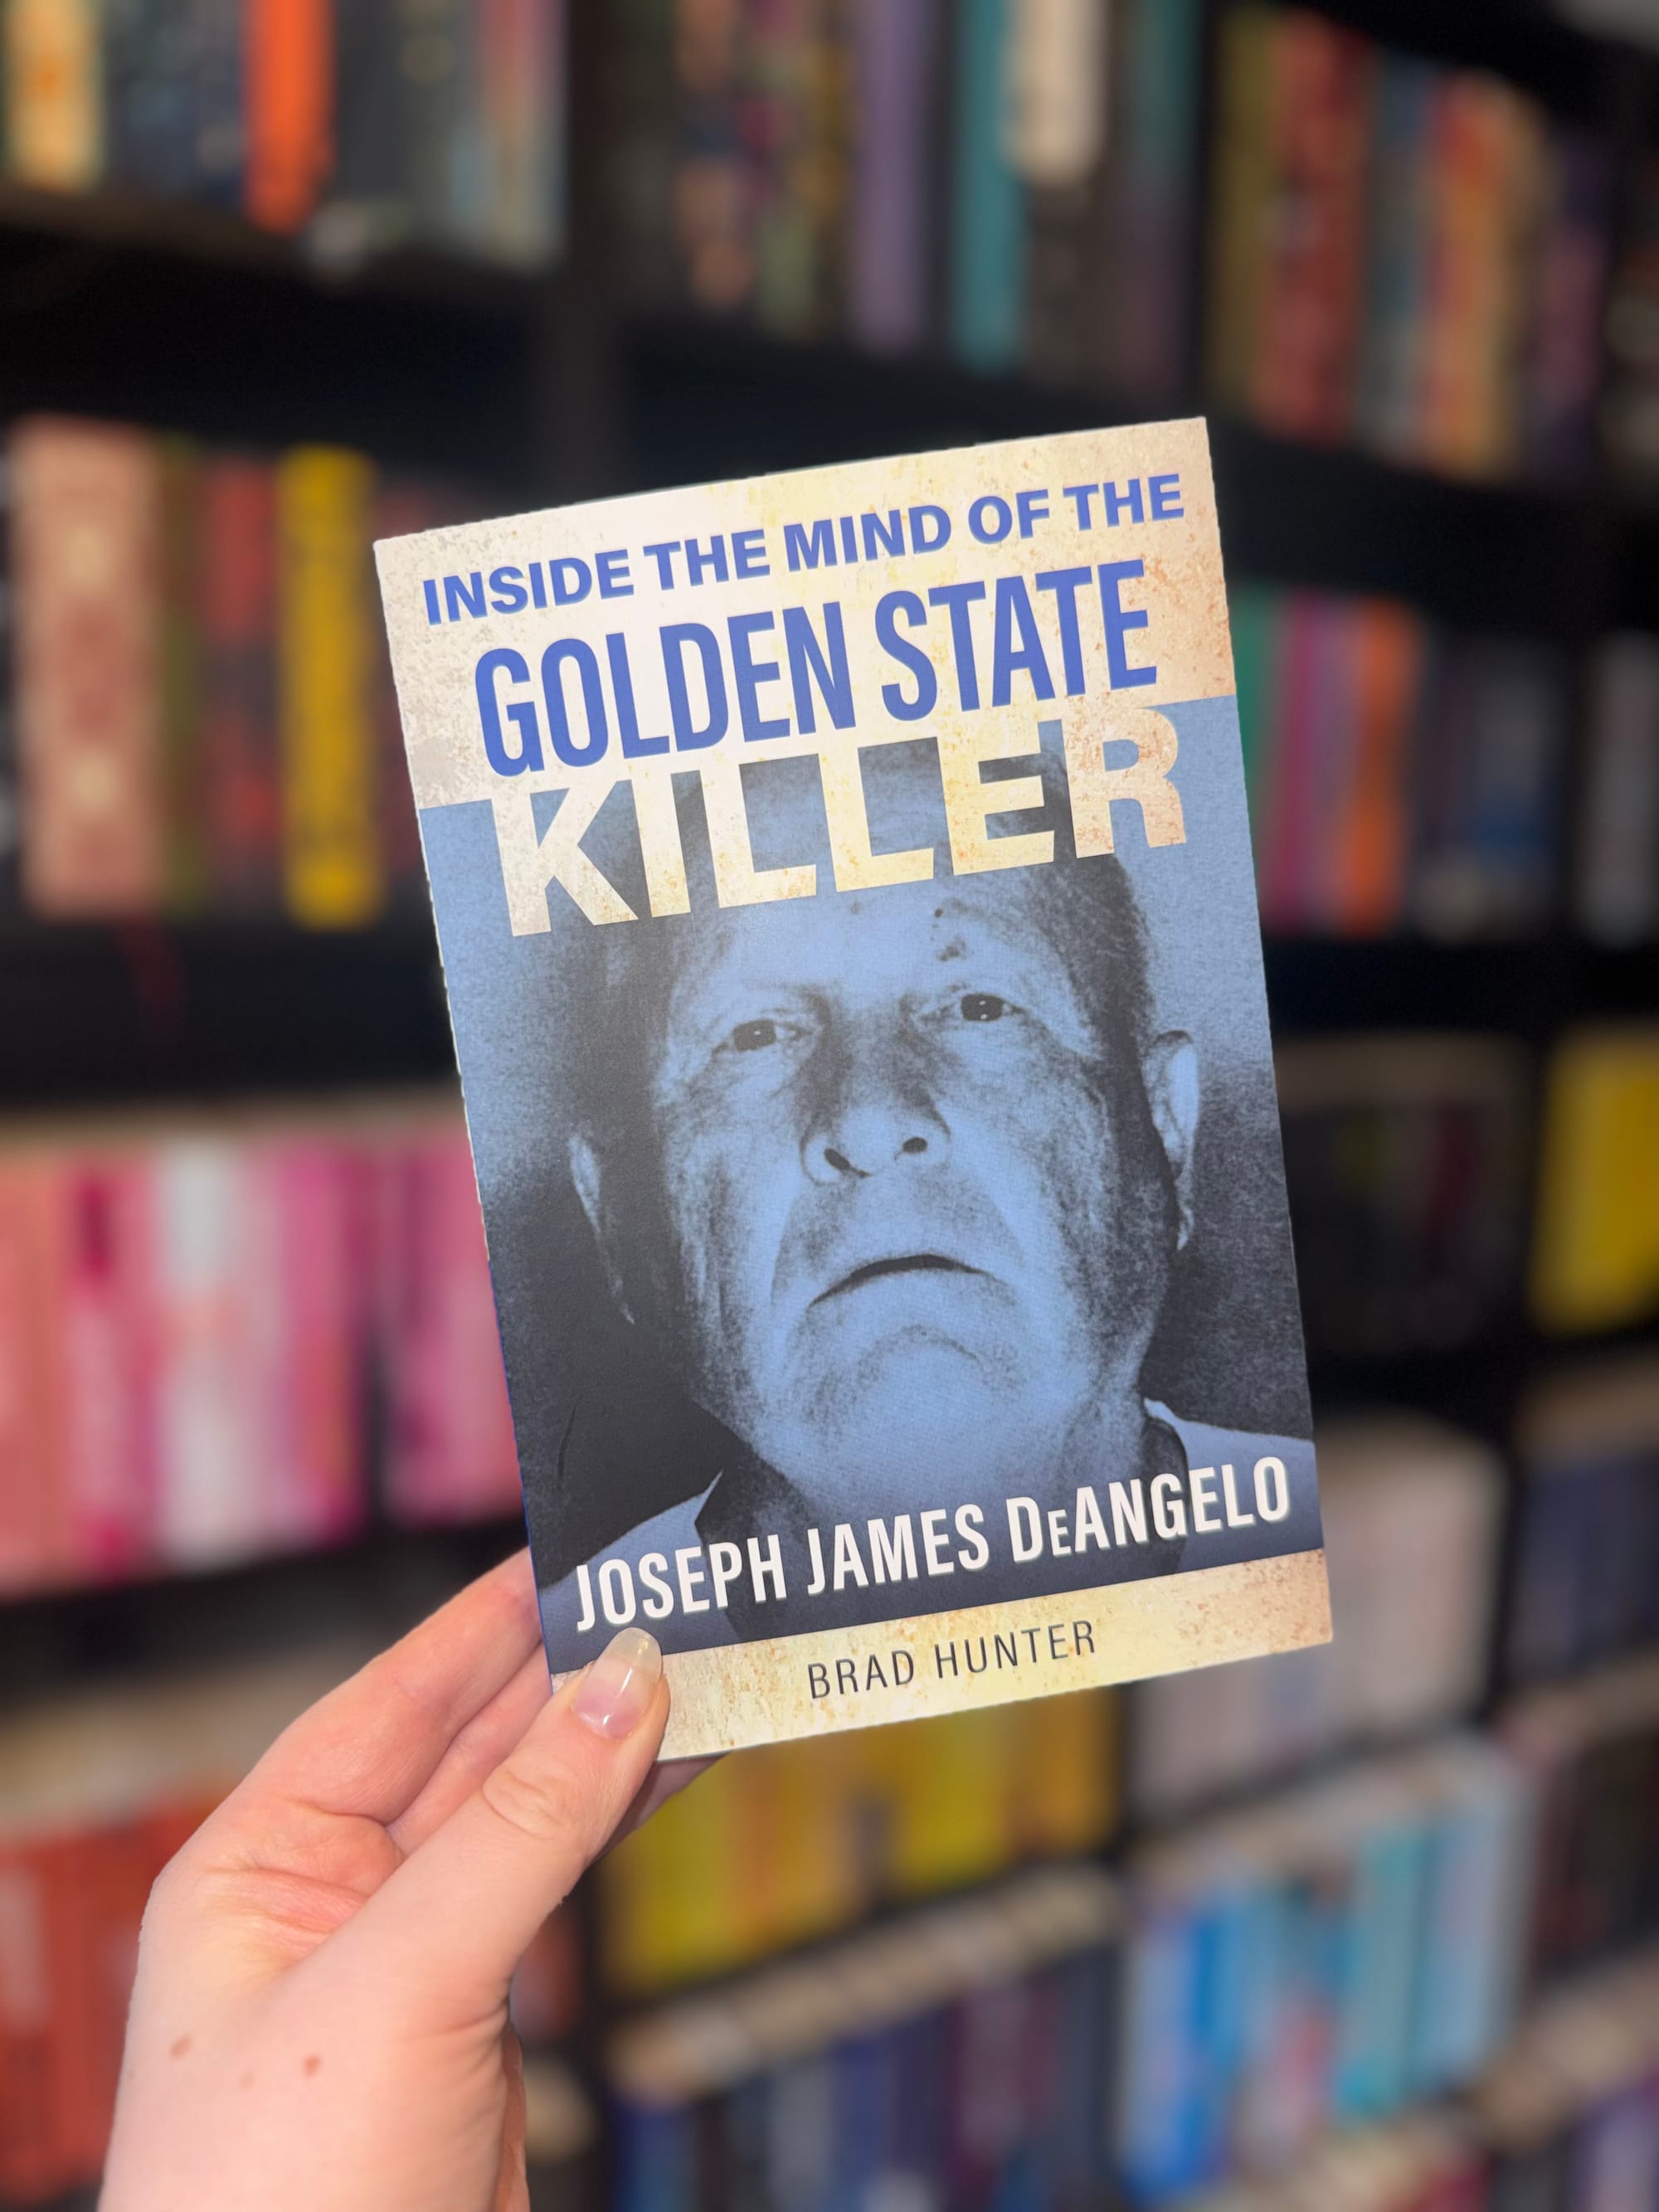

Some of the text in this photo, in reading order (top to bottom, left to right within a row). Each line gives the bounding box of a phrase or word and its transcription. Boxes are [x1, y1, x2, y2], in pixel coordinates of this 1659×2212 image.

[423, 474, 1184, 625] INSIDE THE MIND OF THE
[474, 559, 1157, 777] GOLDEN STATE
[491, 705, 1189, 936] KILLER
[576, 1534, 788, 1631] JOSEPH
[806, 1504, 990, 1596] JAMES
[808, 1620, 1095, 1699] BRAD HUNTER
